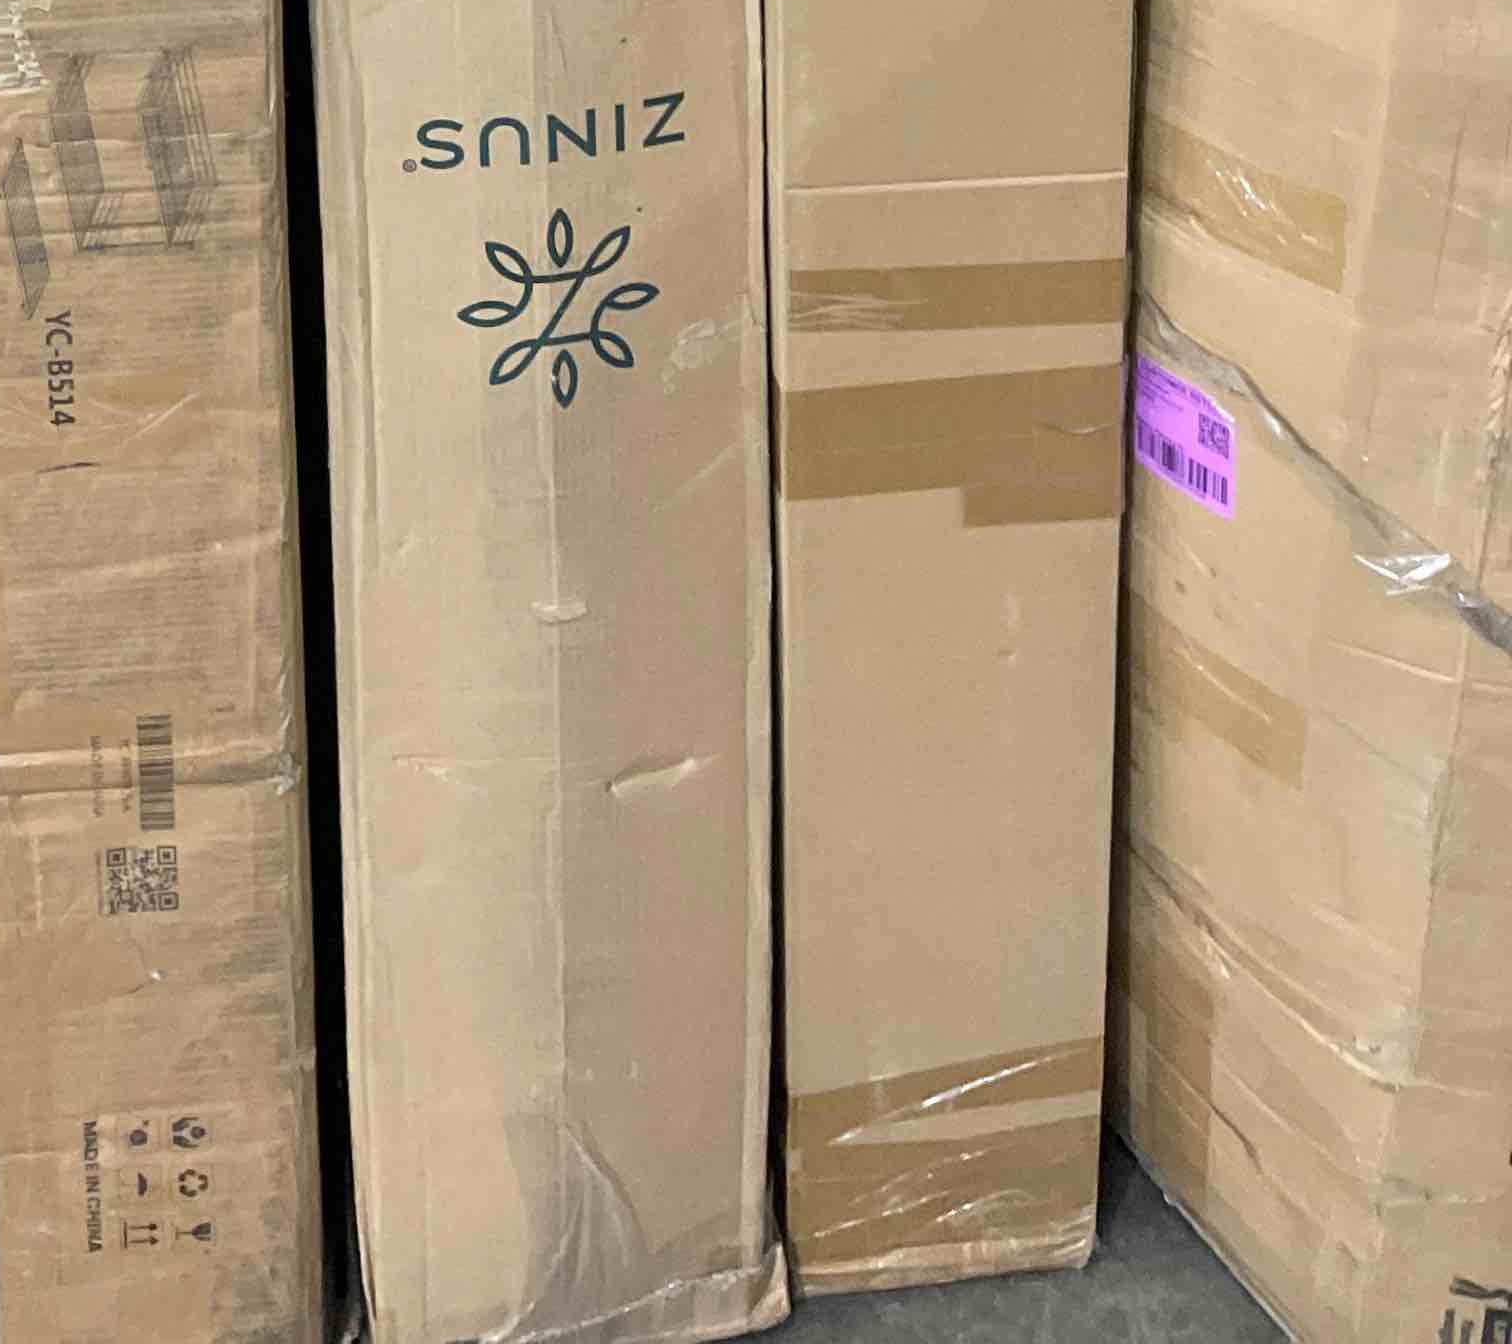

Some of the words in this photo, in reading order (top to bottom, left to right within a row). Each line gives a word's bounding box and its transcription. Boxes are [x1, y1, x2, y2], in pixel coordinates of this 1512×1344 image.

[45, 310, 76, 428] YC-B514
[84, 1121, 99, 1170] MADE
[86, 1176, 101, 1193] IN
[87, 1197, 103, 1253] CHINA
